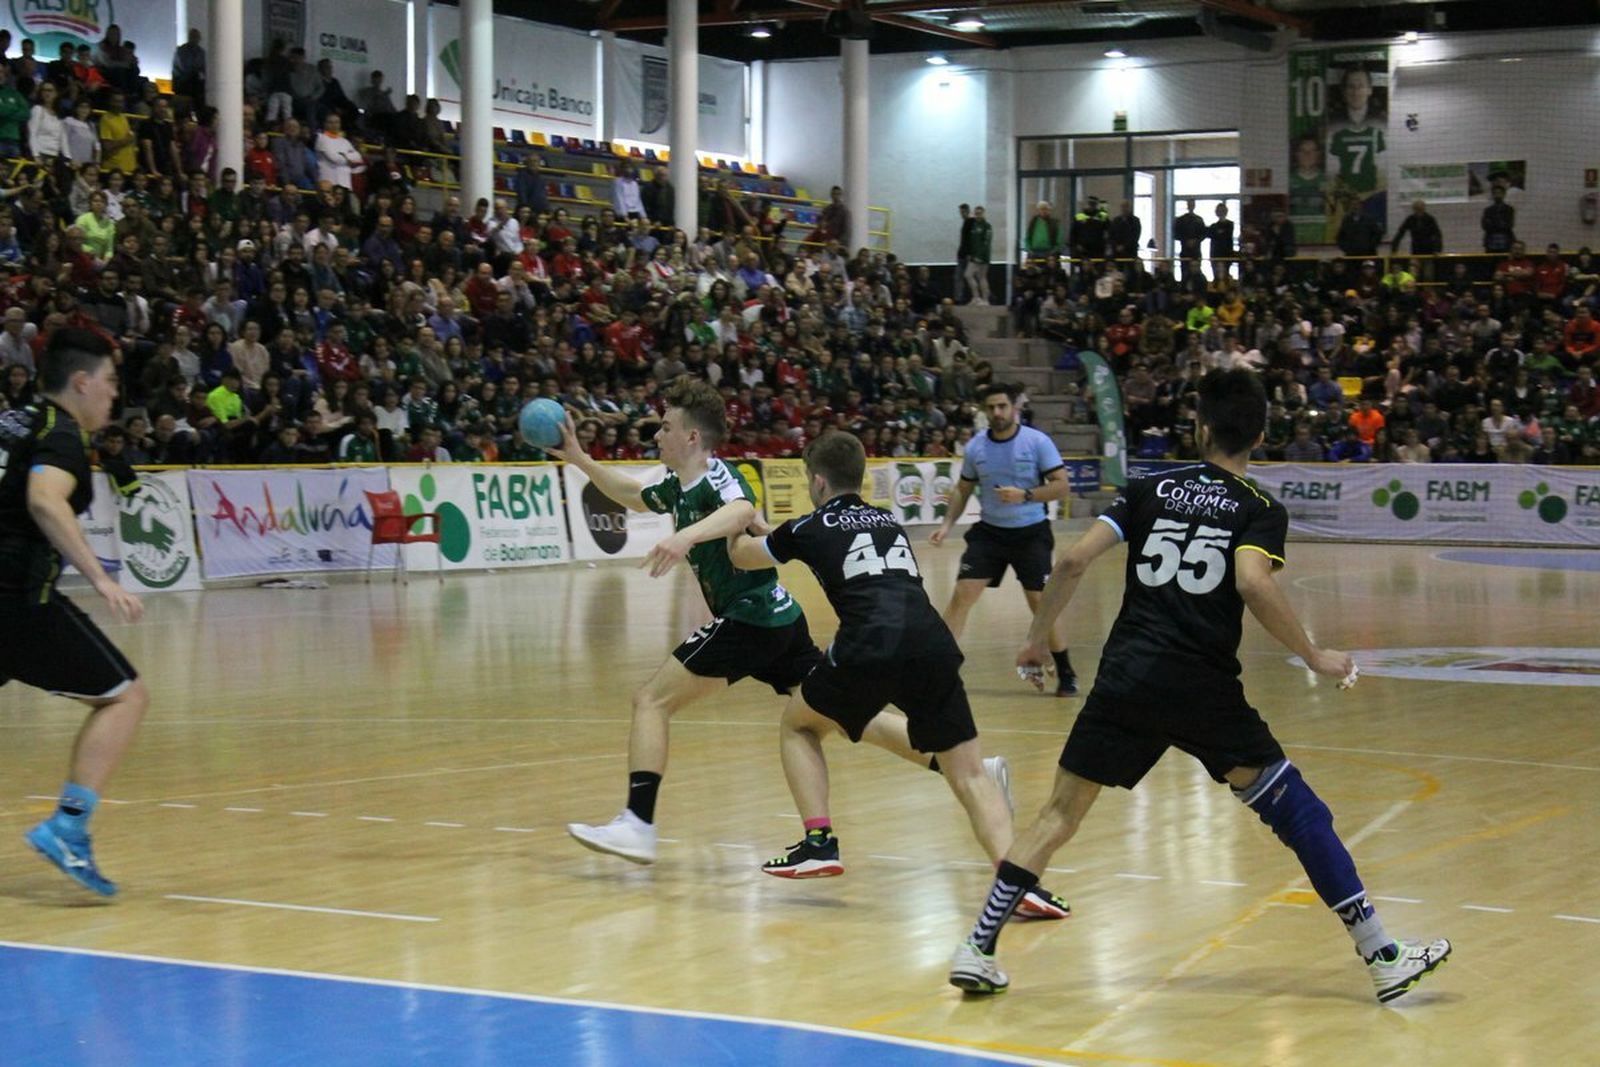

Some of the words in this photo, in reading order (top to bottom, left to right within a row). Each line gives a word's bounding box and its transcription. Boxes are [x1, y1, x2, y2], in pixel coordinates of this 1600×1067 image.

[548, 88, 593, 116] Banco
[1291, 75, 1325, 117] 10
[1347, 144, 1368, 174] 7
[471, 473, 555, 520] FABM
[1183, 479, 1228, 495] GRUPO
[1280, 481, 1341, 500] FABM
[1426, 480, 1490, 502] FABM
[1164, 498, 1219, 519] DENTAL
[842, 533, 918, 580] 44
[1136, 518, 1233, 595] 55
